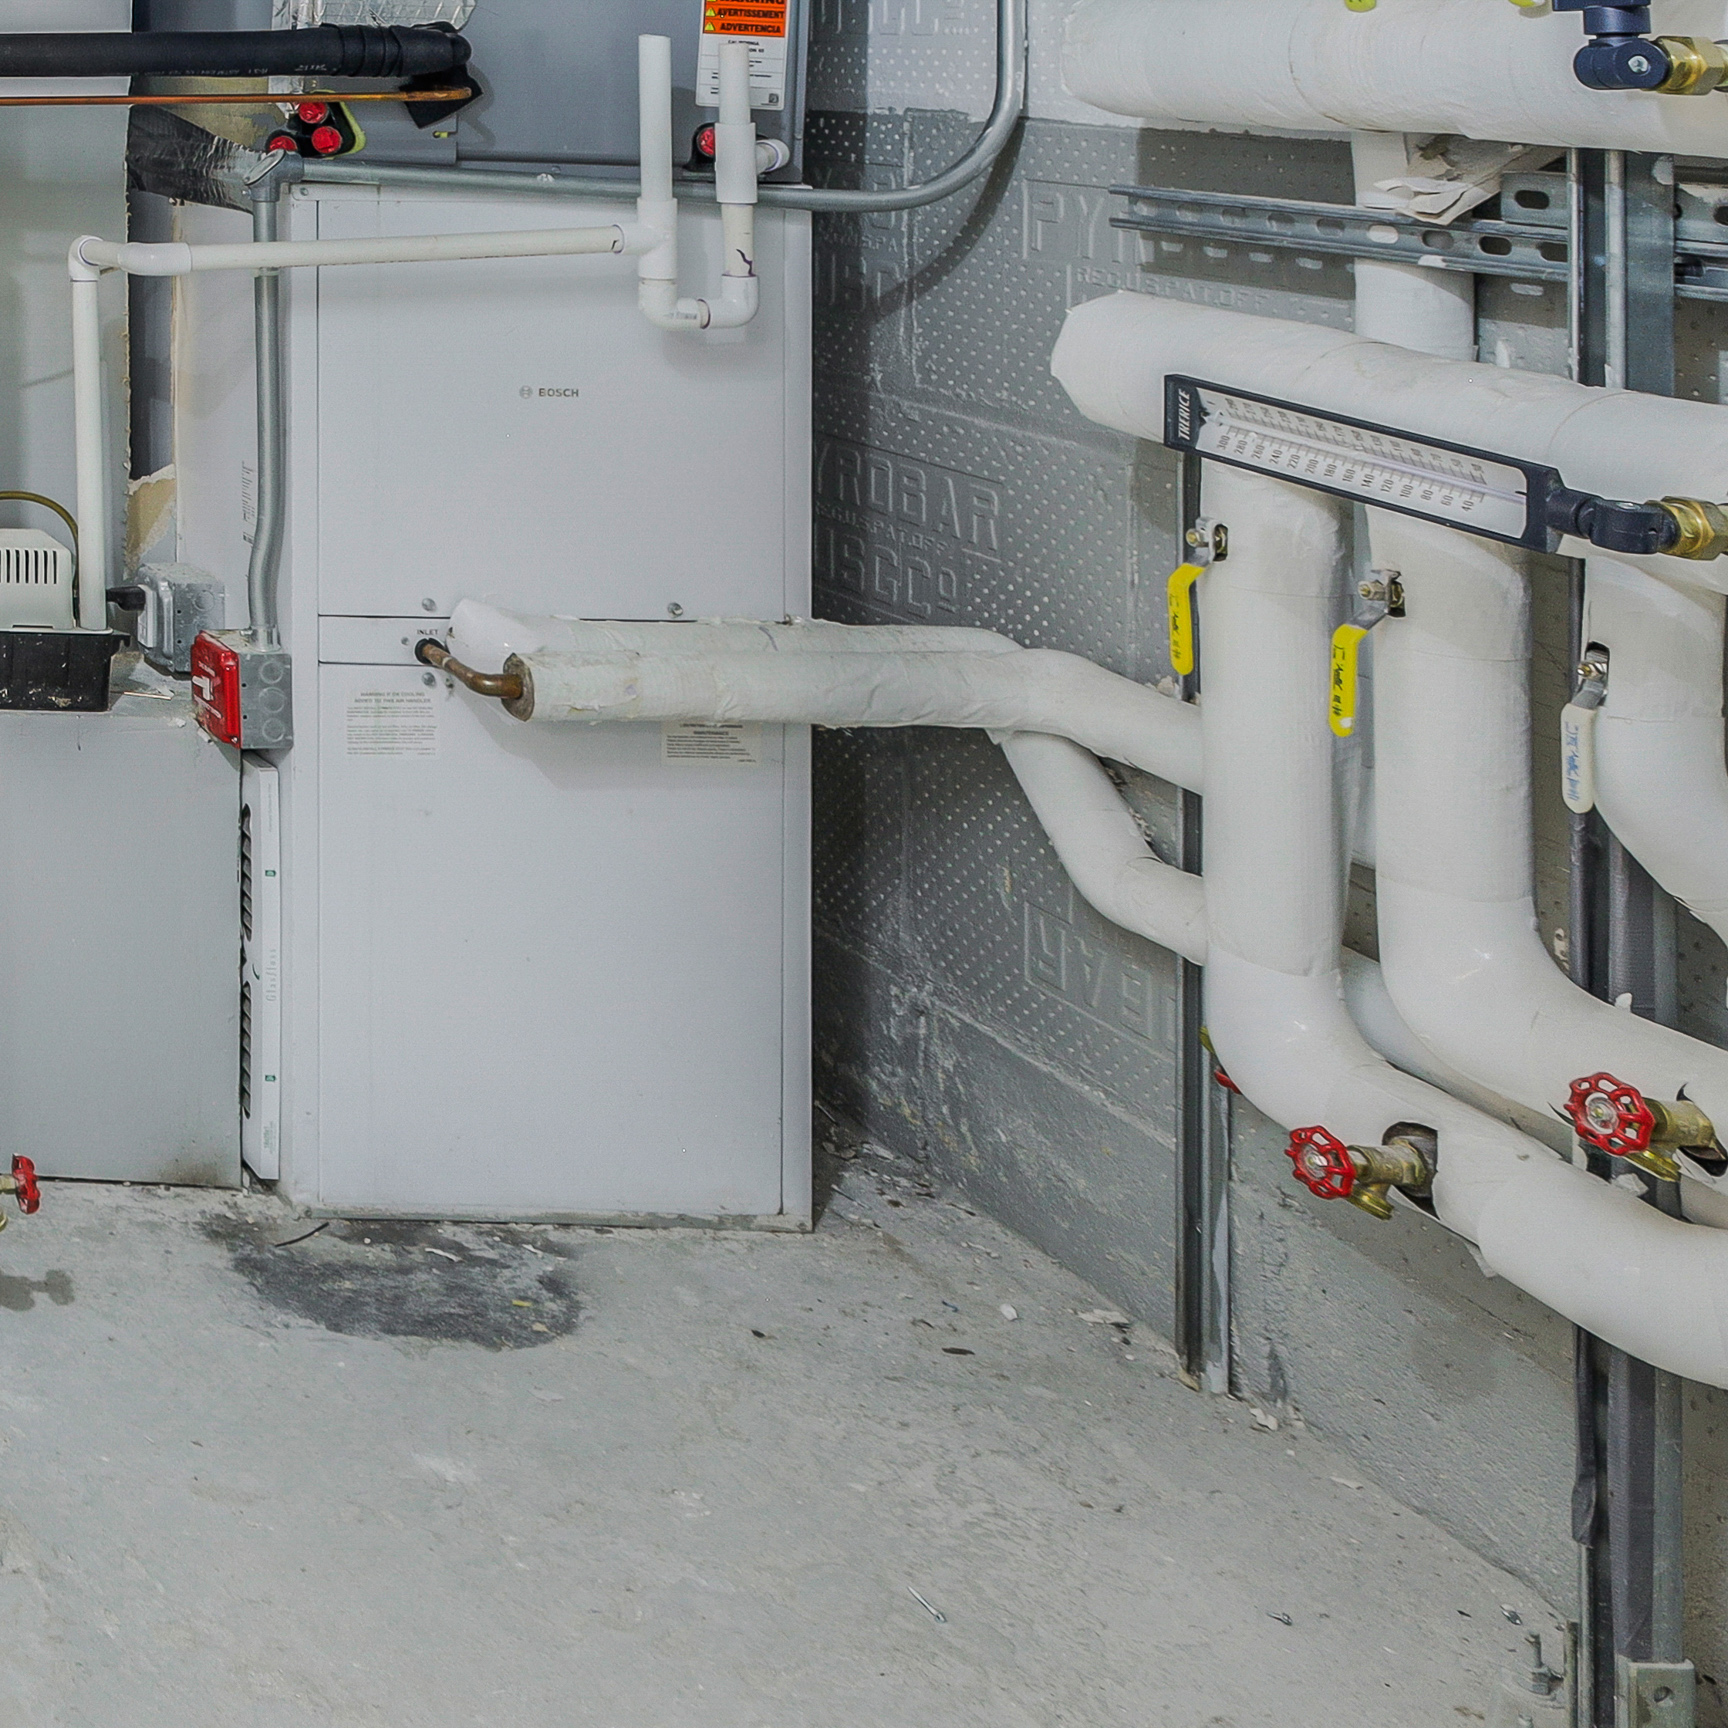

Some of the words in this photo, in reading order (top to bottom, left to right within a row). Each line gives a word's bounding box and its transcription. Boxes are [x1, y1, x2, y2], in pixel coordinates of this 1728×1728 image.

[717, 8, 785, 19] AVERTISSEMENT
[720, 22, 781, 33] ADVERTENCIA
[538, 387, 579, 398] BOSCH
[1178, 388, 1191, 441] TRERICE
[1217, 435, 1231, 450] 300
[1234, 439, 1248, 455] 280
[1251, 444, 1266, 460] 260
[1269, 449, 1283, 465] 240
[1286, 454, 1301, 469] 220
[1305, 458, 1319, 474] 200
[1323, 463, 1338, 478] 180
[1342, 468, 1356, 483] 160
[1361, 473, 1375, 488] 140
[1380, 478, 1394, 493] 120
[1399, 484, 1414, 498] 100
[1420, 489, 1434, 501] 80
[1441, 494, 1454, 507] 60
[1461, 500, 1475, 512] 40
